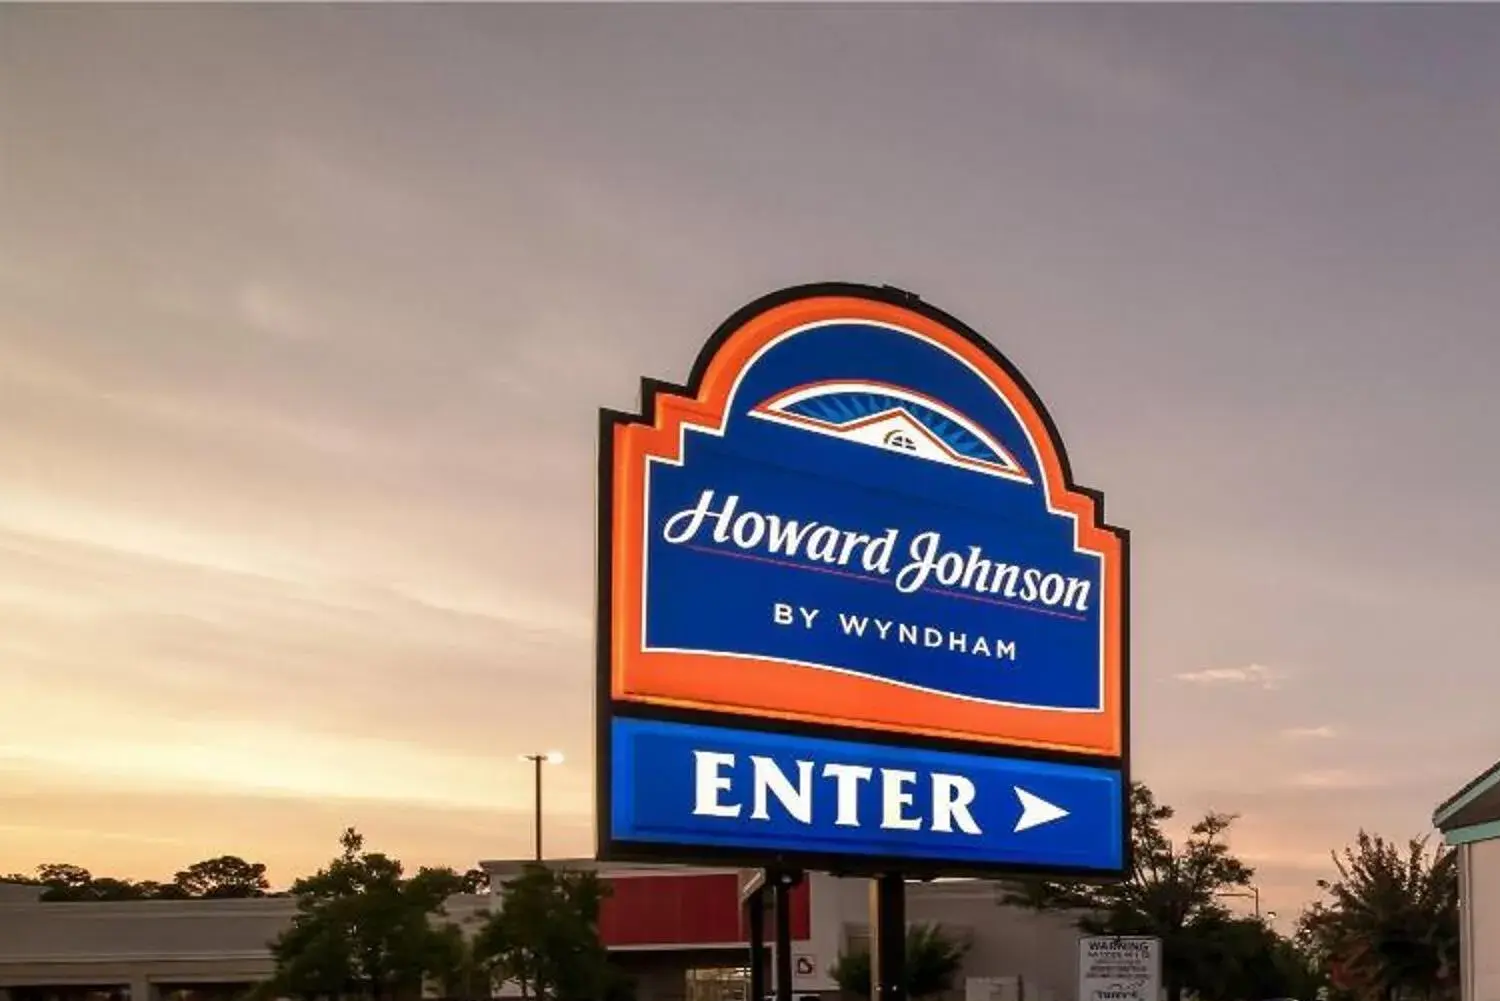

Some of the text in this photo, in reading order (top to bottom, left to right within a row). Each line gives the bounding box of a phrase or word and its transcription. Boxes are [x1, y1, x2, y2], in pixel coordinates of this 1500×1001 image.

[663, 490, 1091, 612] Howard Johnson
[773, 603, 1017, 662] BY WYNDHAM
[692, 750, 982, 835] ENTER
